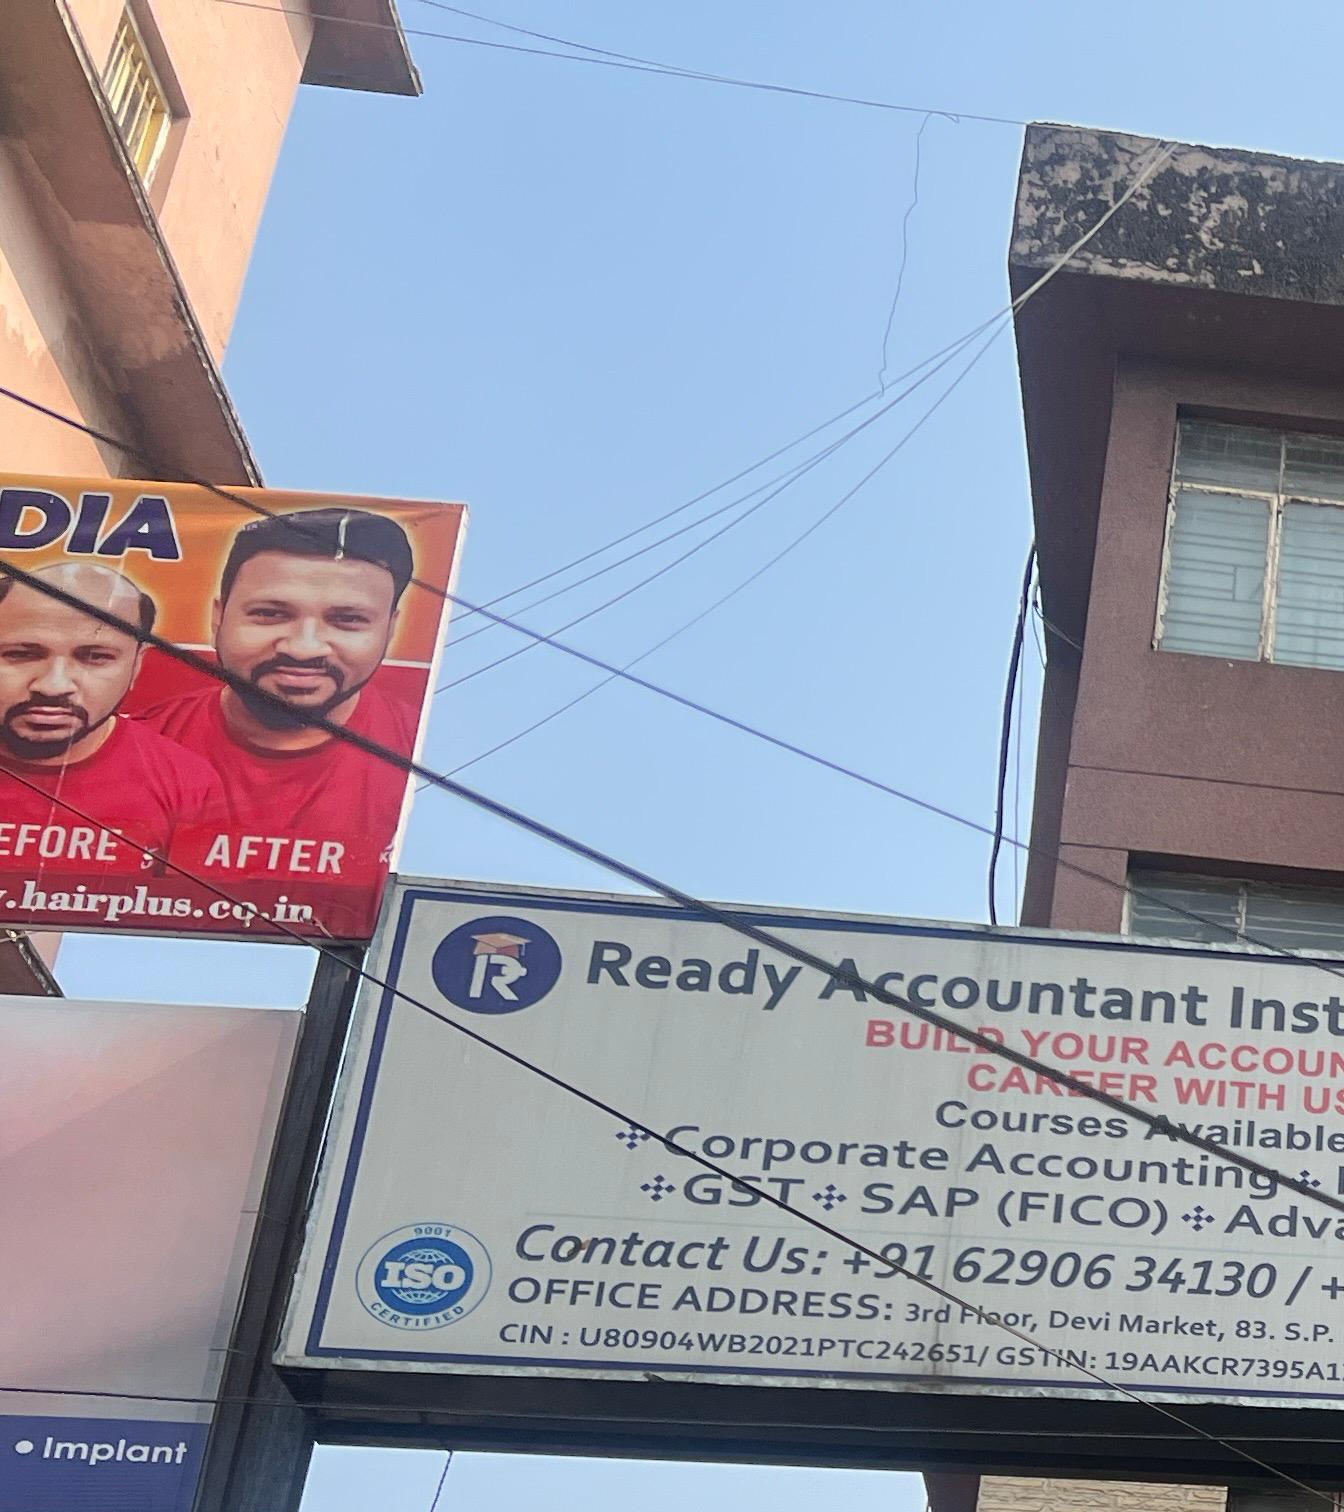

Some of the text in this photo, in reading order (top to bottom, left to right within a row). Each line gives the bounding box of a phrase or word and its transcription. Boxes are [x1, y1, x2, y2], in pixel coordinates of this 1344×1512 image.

[205, 834, 345, 874] AFTER
[587, 940, 803, 1011] Ready
[818, 957, 1208, 1027] Accountant
[865, 1019, 1004, 1056] BUILD
[1021, 1029, 1150, 1066] YOUR
[967, 1063, 1158, 1104] CAREER
[1174, 1077, 1286, 1113] WITH
[935, 1100, 1129, 1138] Courses
[664, 1125, 949, 1171] Corporate
[965, 1142, 1280, 1200] Accounting
[682, 1173, 806, 1209] GST
[860, 1182, 980, 1219] SAP
[996, 1190, 1169, 1236] (FICO)
[381, 1261, 466, 1291] ISO
[515, 1224, 730, 1271] Contact
[743, 1235, 829, 1276] Us:
[842, 1242, 936, 1281] +91
[952, 1247, 1116, 1290] 62906
[1125, 1255, 1278, 1299] 34130
[370, 1302, 465, 1327] CERTIFIED
[508, 1276, 663, 1310] OFFICE
[671, 1285, 893, 1322] ADDRESS:
[904, 1301, 951, 1325] 3rd
[960, 1305, 1038, 1333] Floor,
[1049, 1309, 1111, 1332] Devi
[1119, 1313, 1225, 1342] Market,
[1235, 1320, 1275, 1340] 83.
[1284, 1322, 1335, 1343] S.P.
[498, 1323, 553, 1345] CIN
[996, 1349, 1097, 1369] GSTIN:
[42, 1436, 188, 1466] Implant
